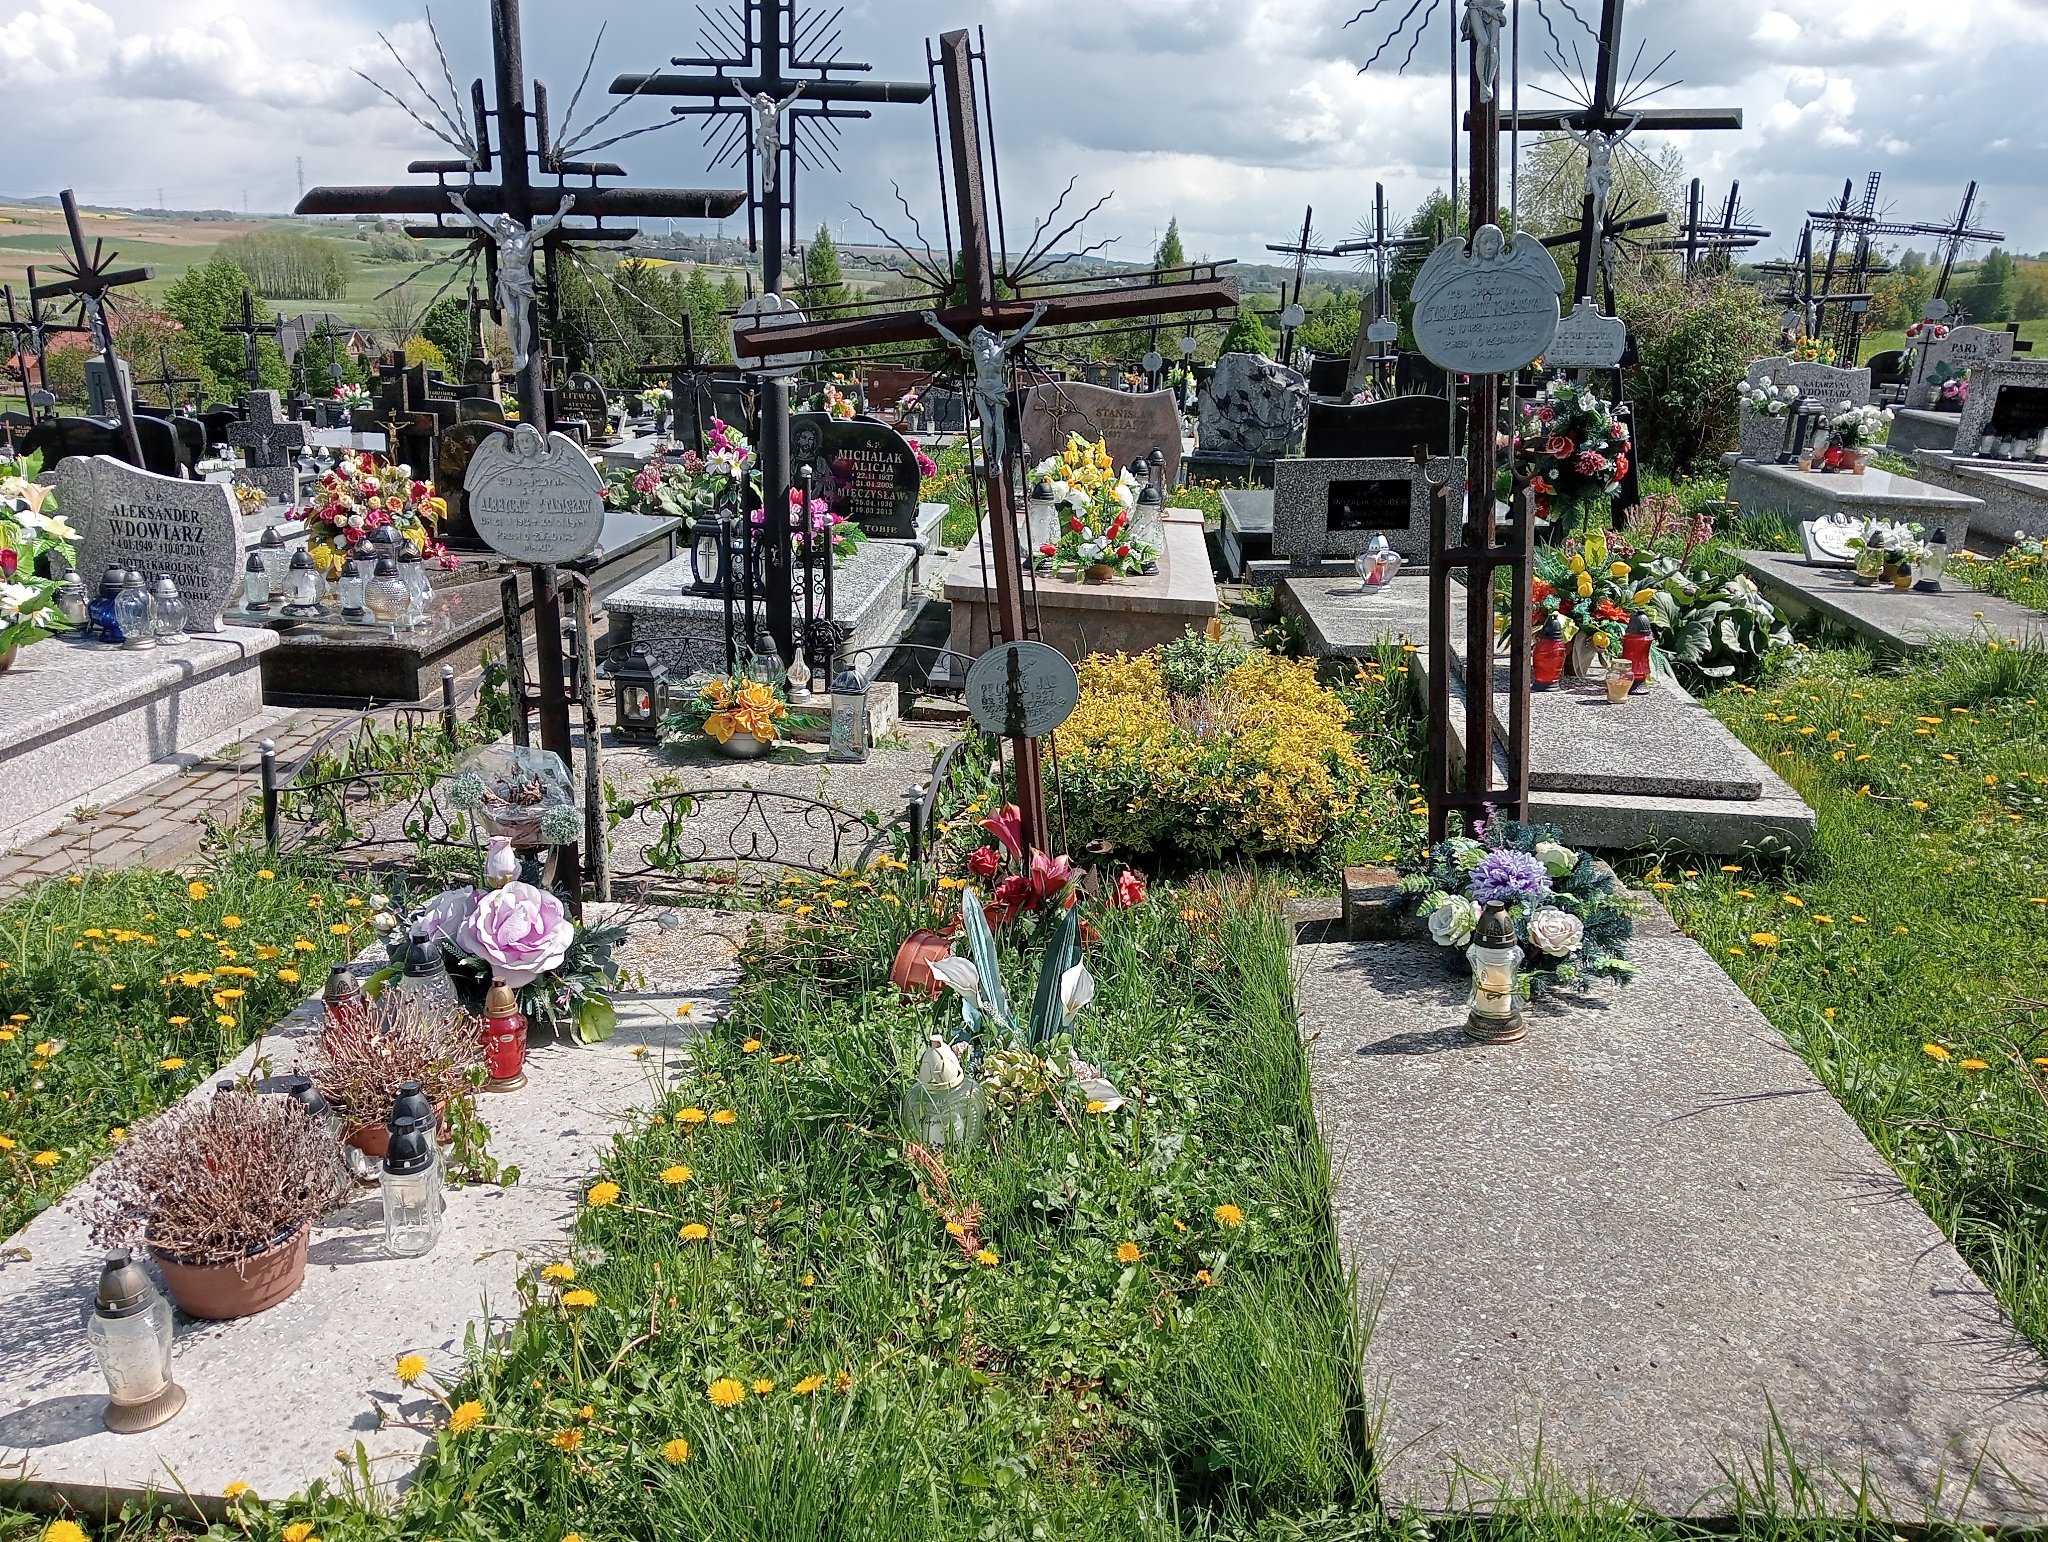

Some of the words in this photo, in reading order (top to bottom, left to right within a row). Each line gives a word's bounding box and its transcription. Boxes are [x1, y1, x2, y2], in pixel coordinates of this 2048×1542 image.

[562, 392, 598, 401] LITWIN
[837, 449, 903, 464] MICHALAK
[851, 461, 894, 473] ALICJA
[837, 487, 906, 501] MIECZYSŁAW
[112, 504, 200, 523] ALEKSANDER
[108, 519, 205, 543] WDOWIARZ
[864, 524, 898, 534] TOBIE
[118, 556, 146, 569] PIOTR
[151, 560, 201, 575] KAROLINA
[178, 590, 212, 601] TOBIE
